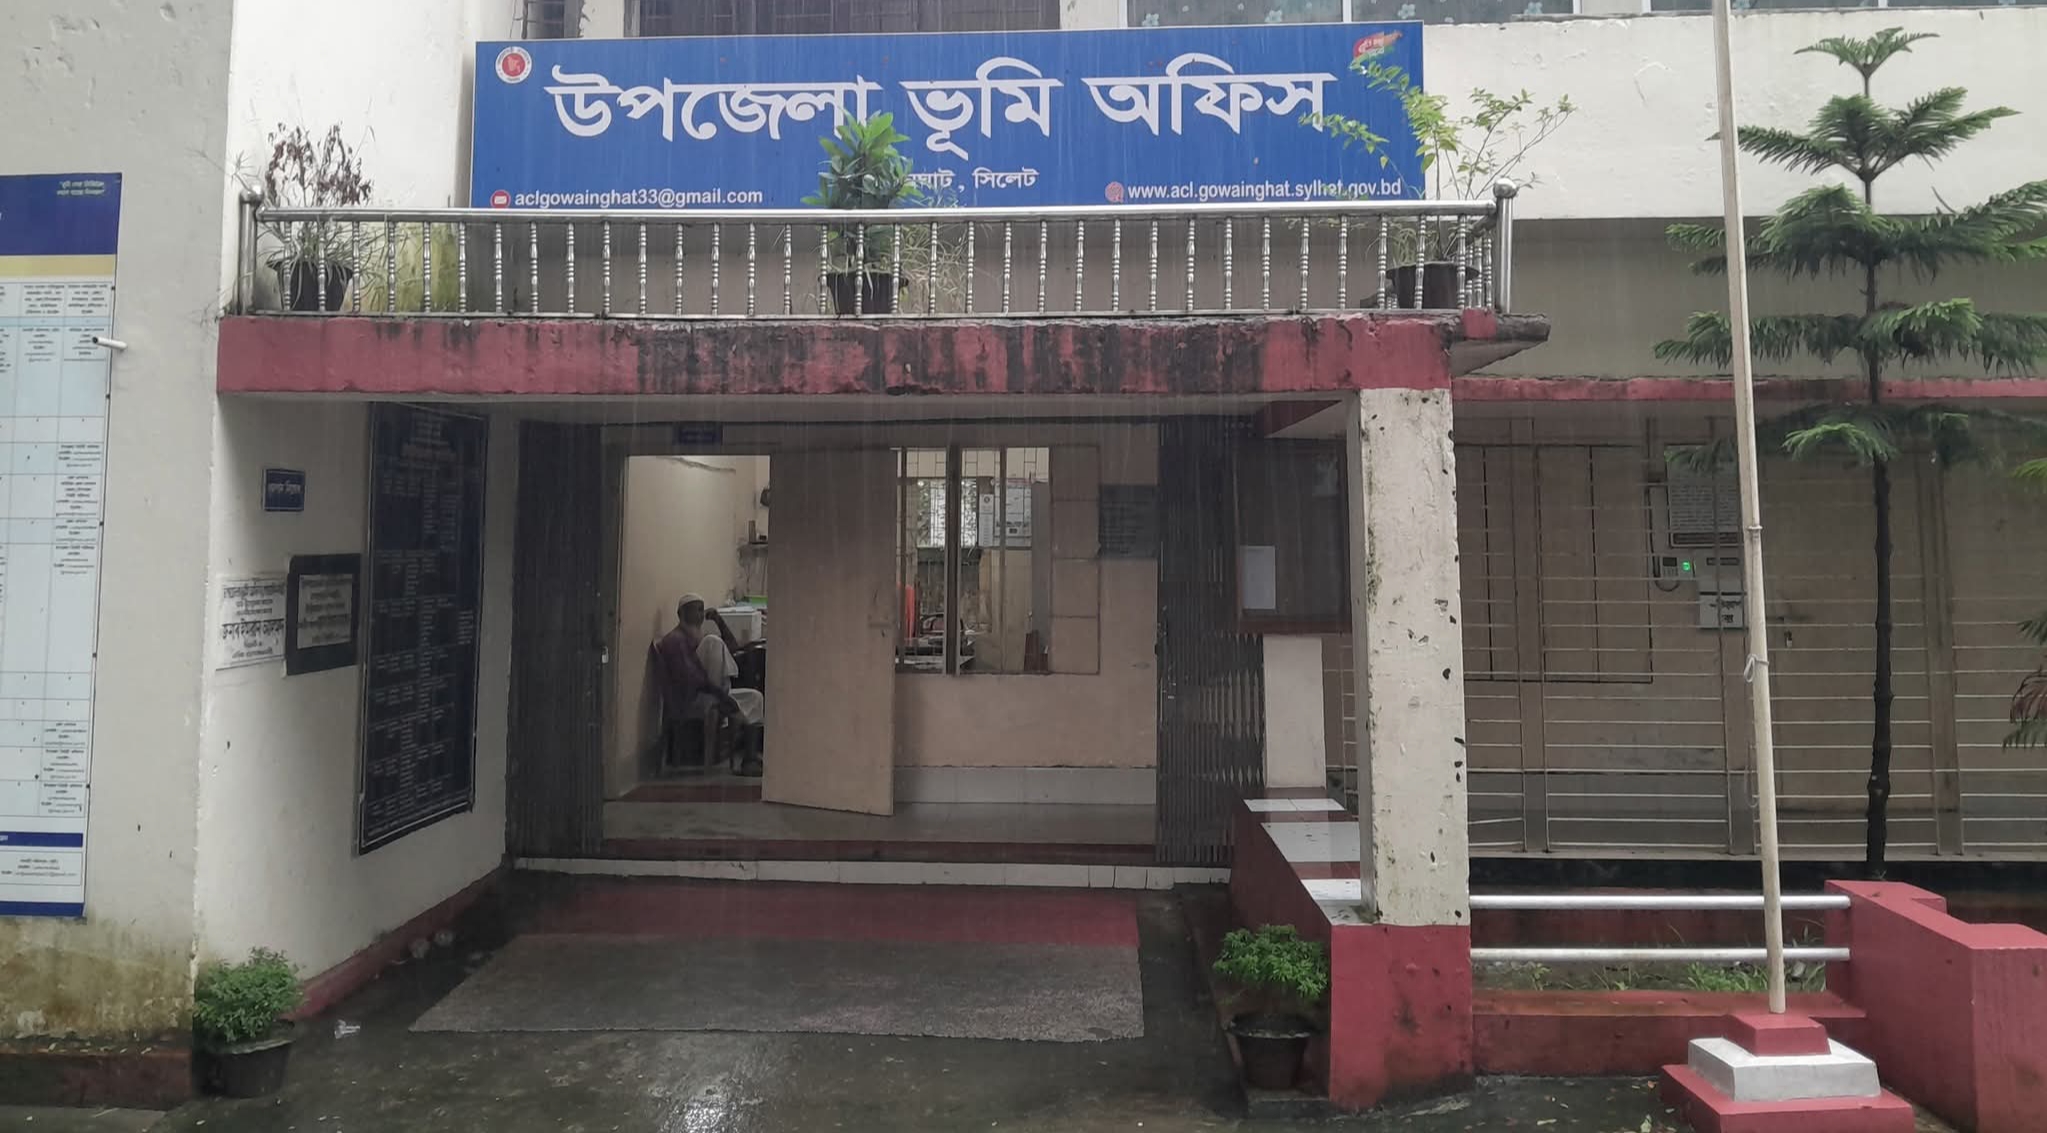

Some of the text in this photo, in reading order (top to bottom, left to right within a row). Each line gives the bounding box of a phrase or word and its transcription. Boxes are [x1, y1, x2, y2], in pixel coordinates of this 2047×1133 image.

[543, 64, 883, 142] উপজেলা
[899, 56, 1065, 161] ভূমি
[1081, 52, 1338, 135] অফিস
[972, 166, 1040, 189] সিলেট
[514, 188, 764, 210] aclgowainghat33@gmail.com
[1127, 178, 1402, 202] www.acl.gowainghat.sylhet.gov.bd
